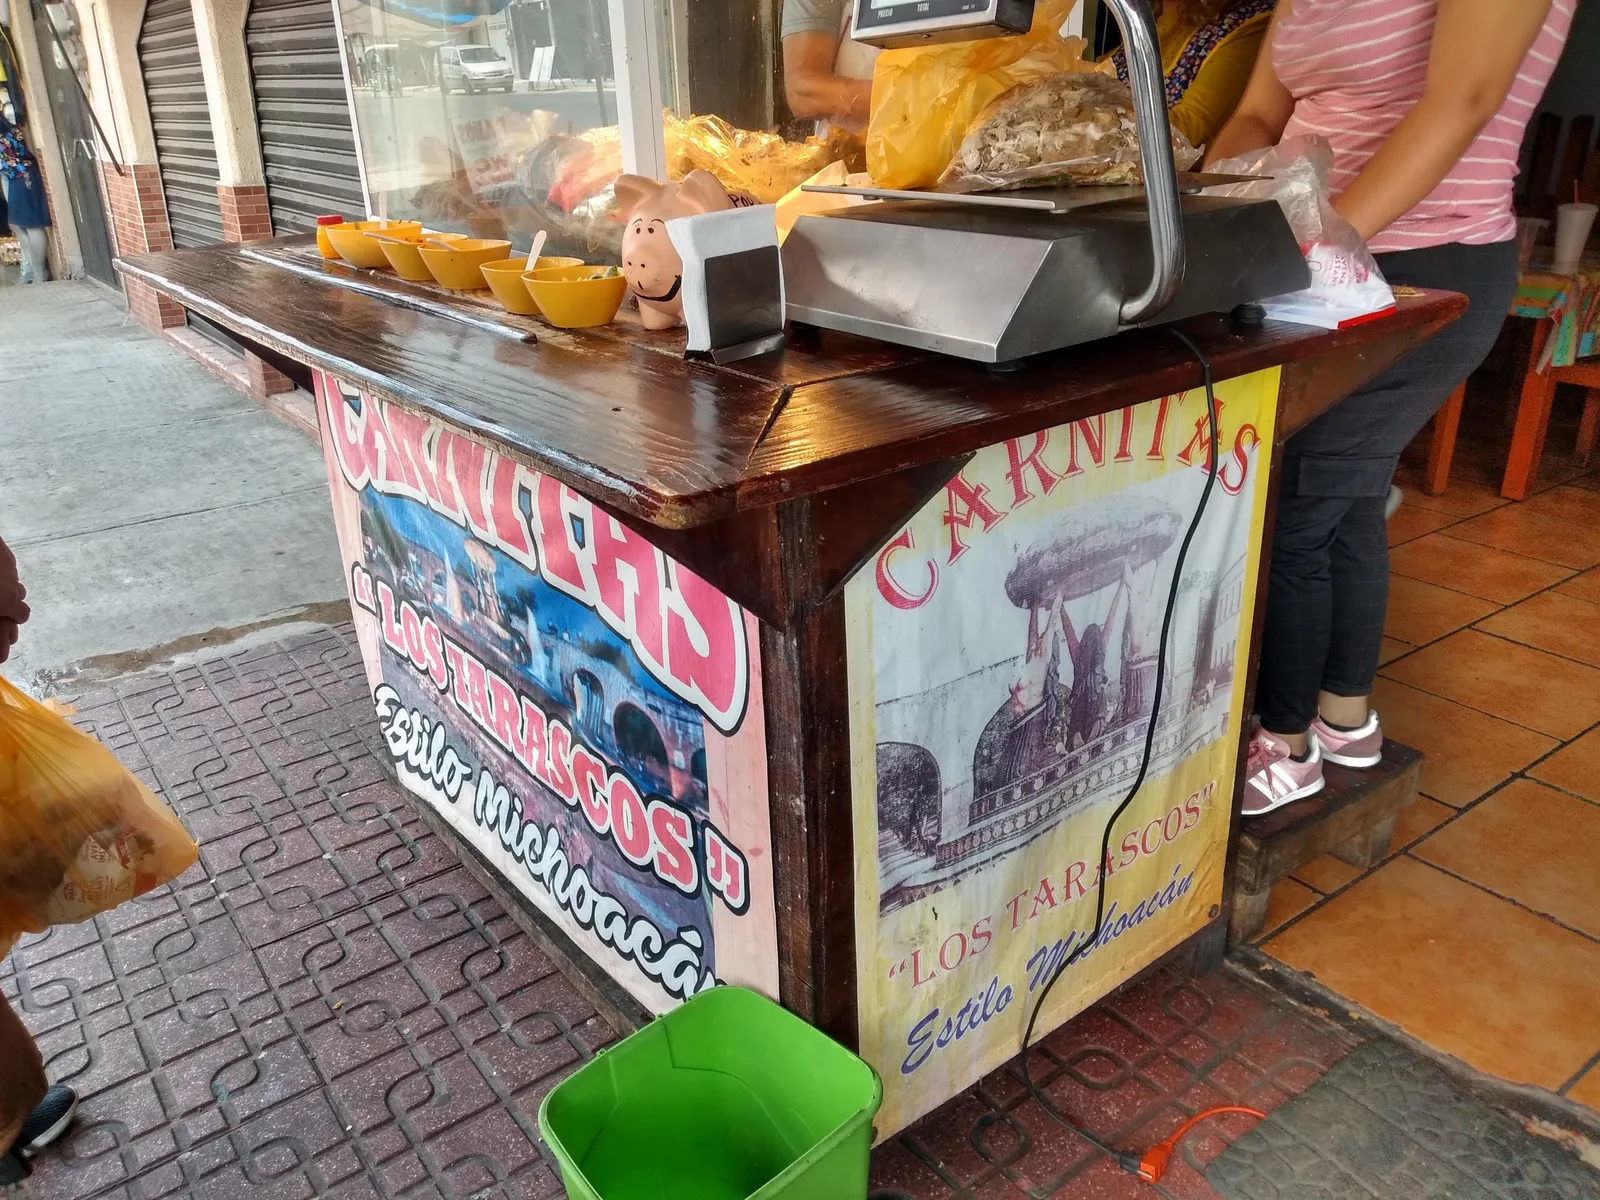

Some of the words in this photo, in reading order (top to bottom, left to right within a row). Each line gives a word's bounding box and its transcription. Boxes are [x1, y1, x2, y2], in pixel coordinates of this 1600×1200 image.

[877, 8, 894, 19] PRECIO
[917, 3, 930, 13] TOTAL
[875, 389, 1261, 610] CARNITAS
[375, 684, 472, 801] Estilo
[901, 976, 1014, 1075] Estilo
